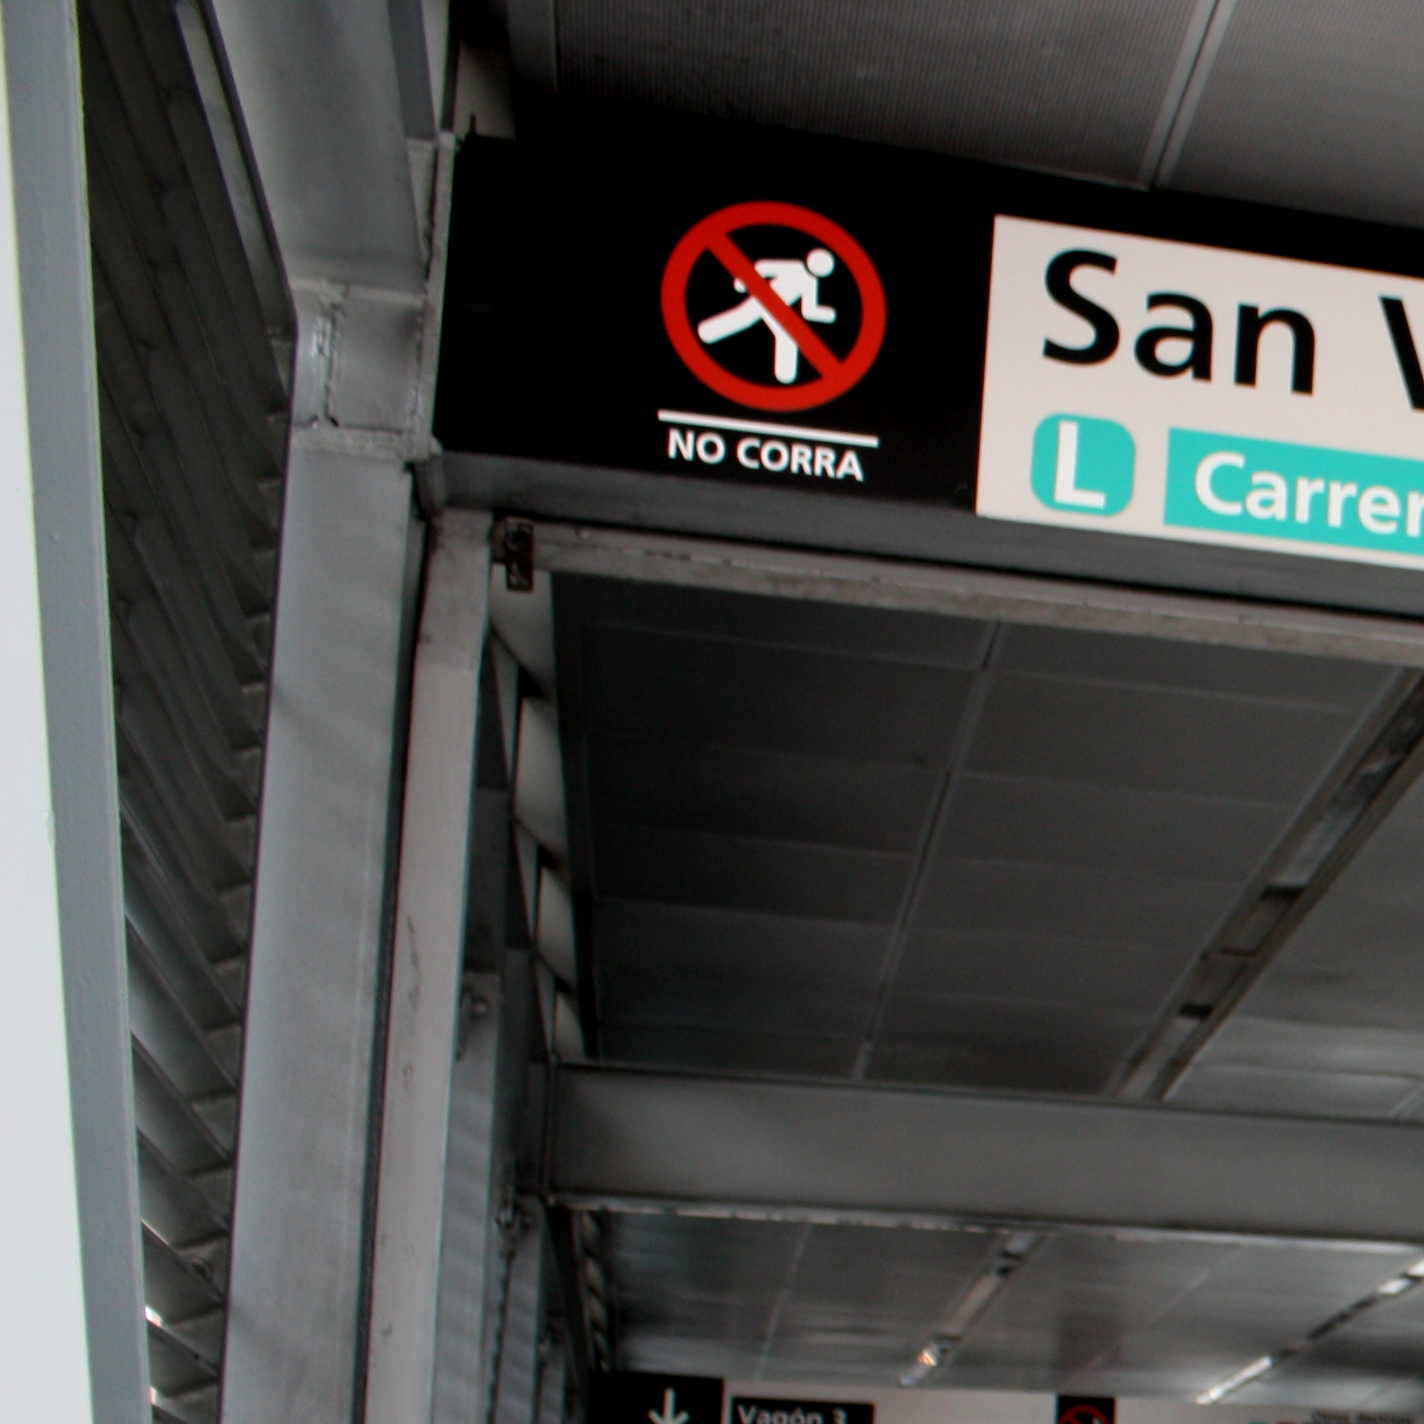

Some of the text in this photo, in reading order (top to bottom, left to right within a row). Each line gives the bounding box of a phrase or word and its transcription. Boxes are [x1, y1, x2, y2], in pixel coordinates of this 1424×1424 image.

[1043, 248, 1316, 396] San
[667, 428, 864, 483] NO CORRA
[1052, 420, 1107, 509] L
